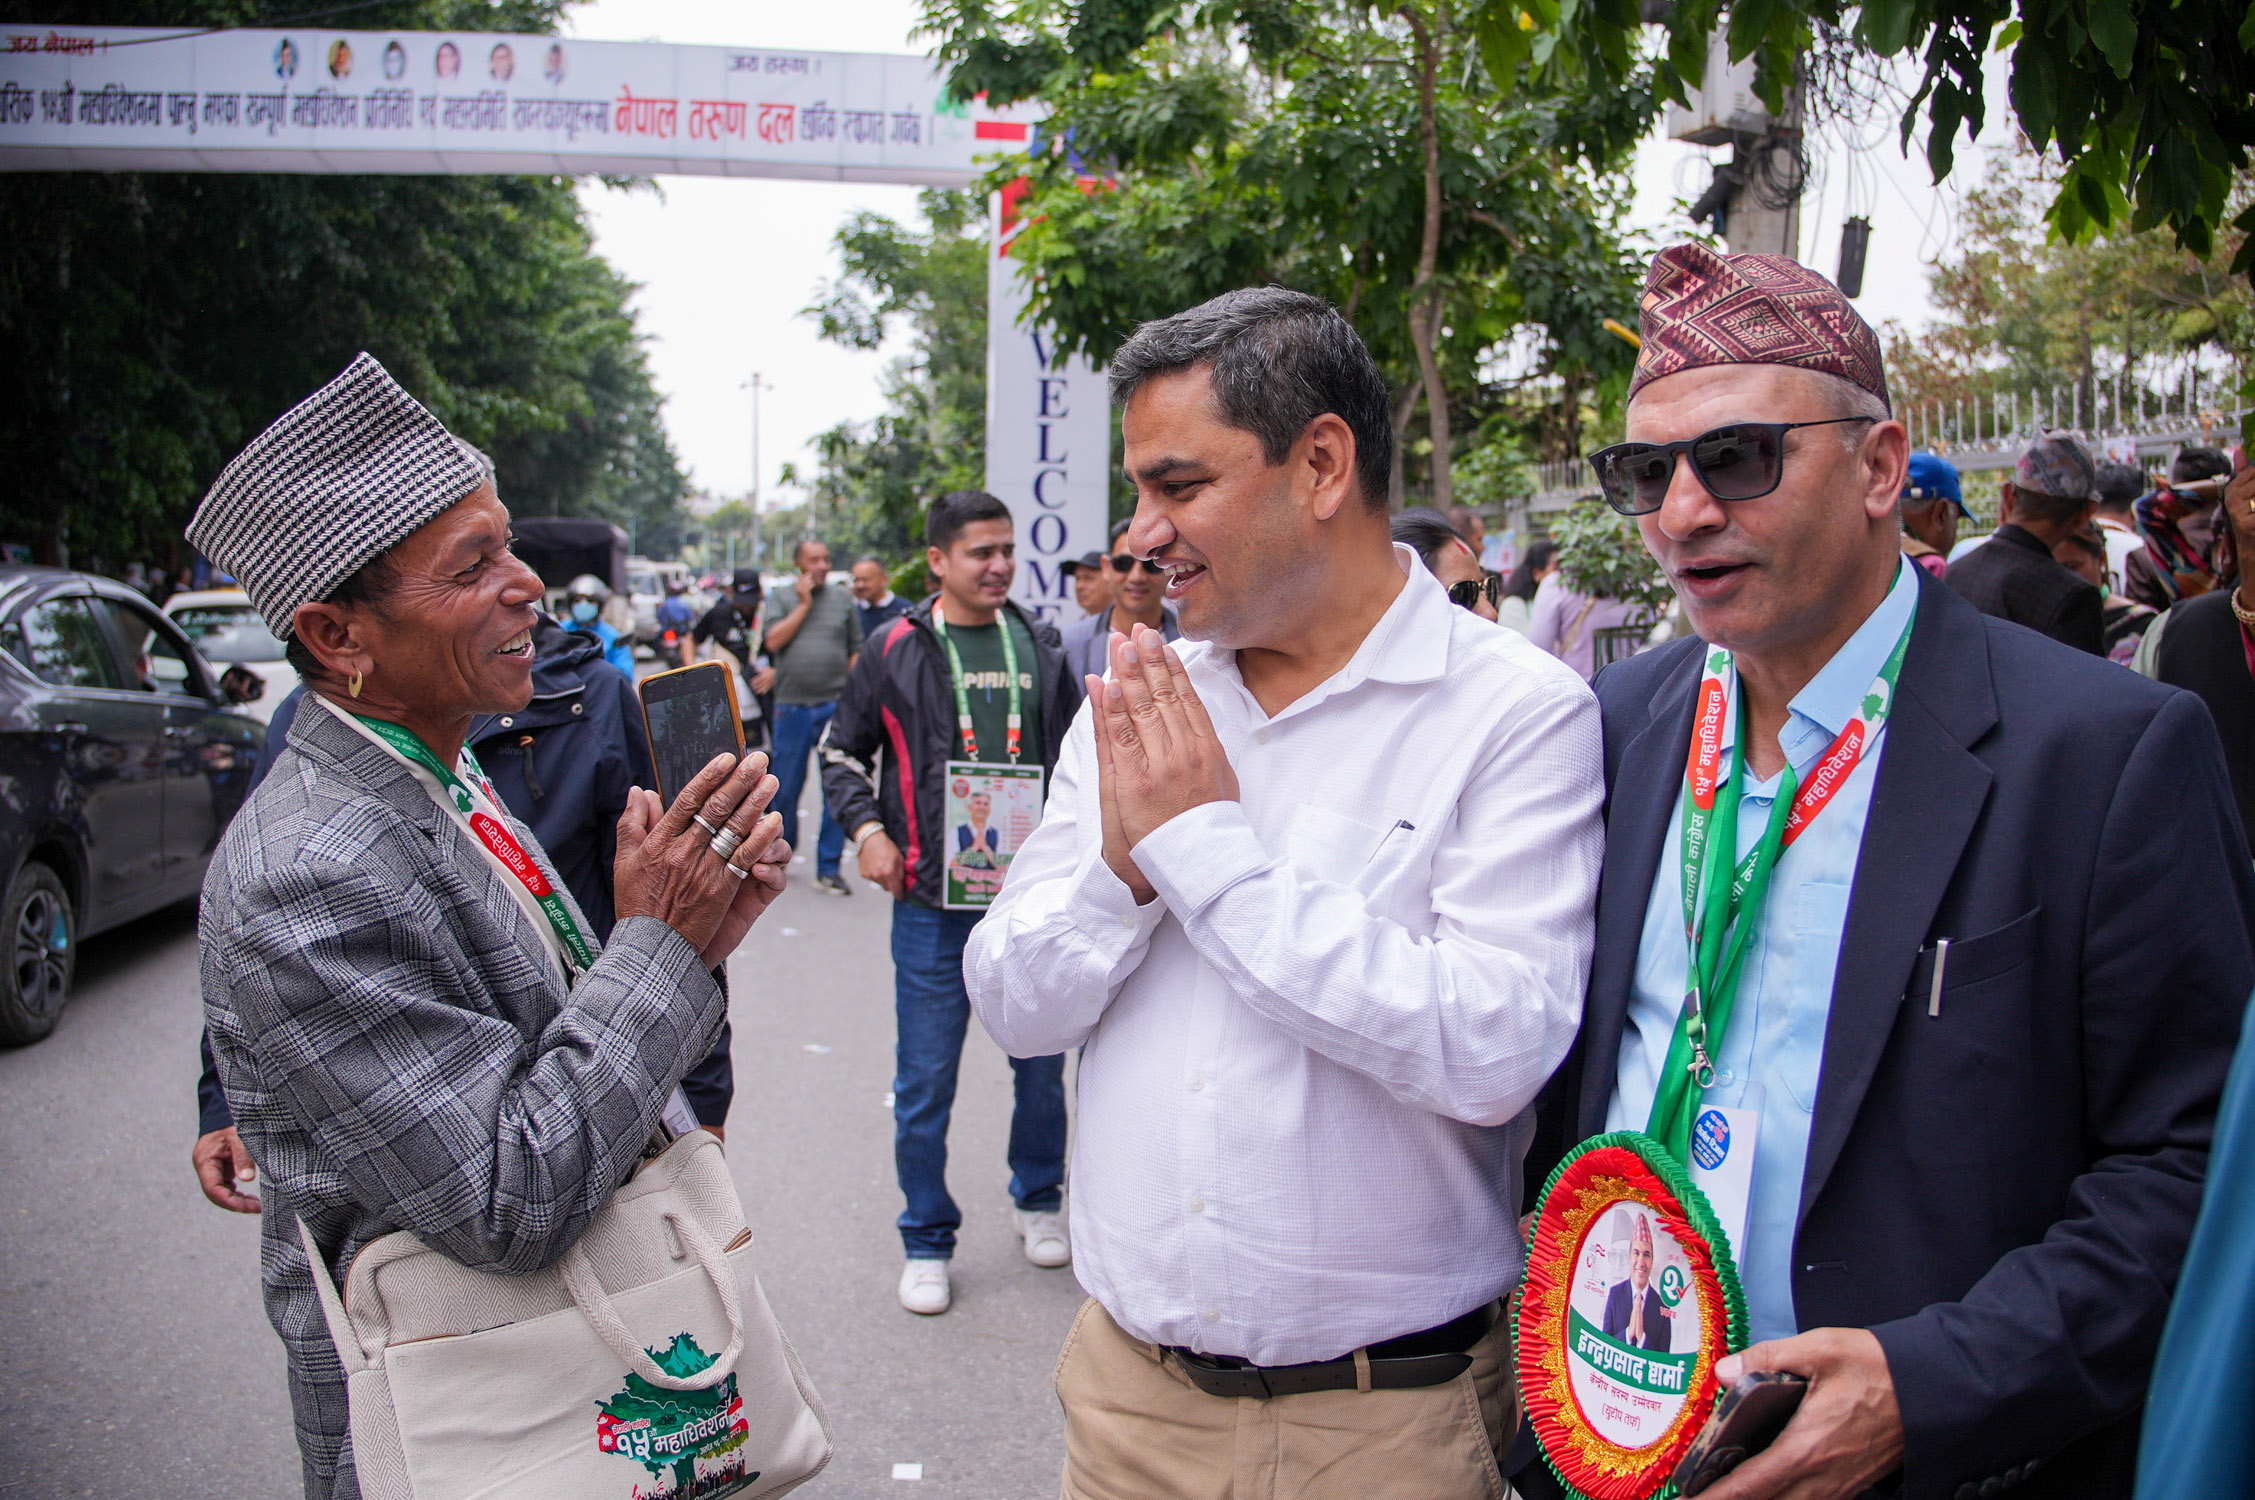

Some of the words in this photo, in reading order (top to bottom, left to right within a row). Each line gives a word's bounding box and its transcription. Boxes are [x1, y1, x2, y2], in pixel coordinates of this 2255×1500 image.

[615, 83, 678, 138] नेपाल
[688, 100, 748, 141] तरुण
[757, 103, 796, 144] दल
[1686, 812, 1705, 861] कांग्रेस
[1699, 689, 1723, 766] महाधिवेशन
[1801, 732, 1862, 807] महाधिवेशन
[480, 817, 527, 874] महाधिवेशन
[543, 898, 571, 931] कांग्रेस
[1663, 1269, 1679, 1301] २
[1577, 1328, 1648, 1384] इन्द्रप्रसाद
[1648, 1360, 1686, 1390] शर्मा
[1589, 1371, 1609, 1393] केन्द्रीय
[1611, 1385, 1629, 1402] सदस्य
[1632, 1395, 1662, 1413] उम्मेदवार
[653, 1409, 730, 1454] महाधिवेशन
